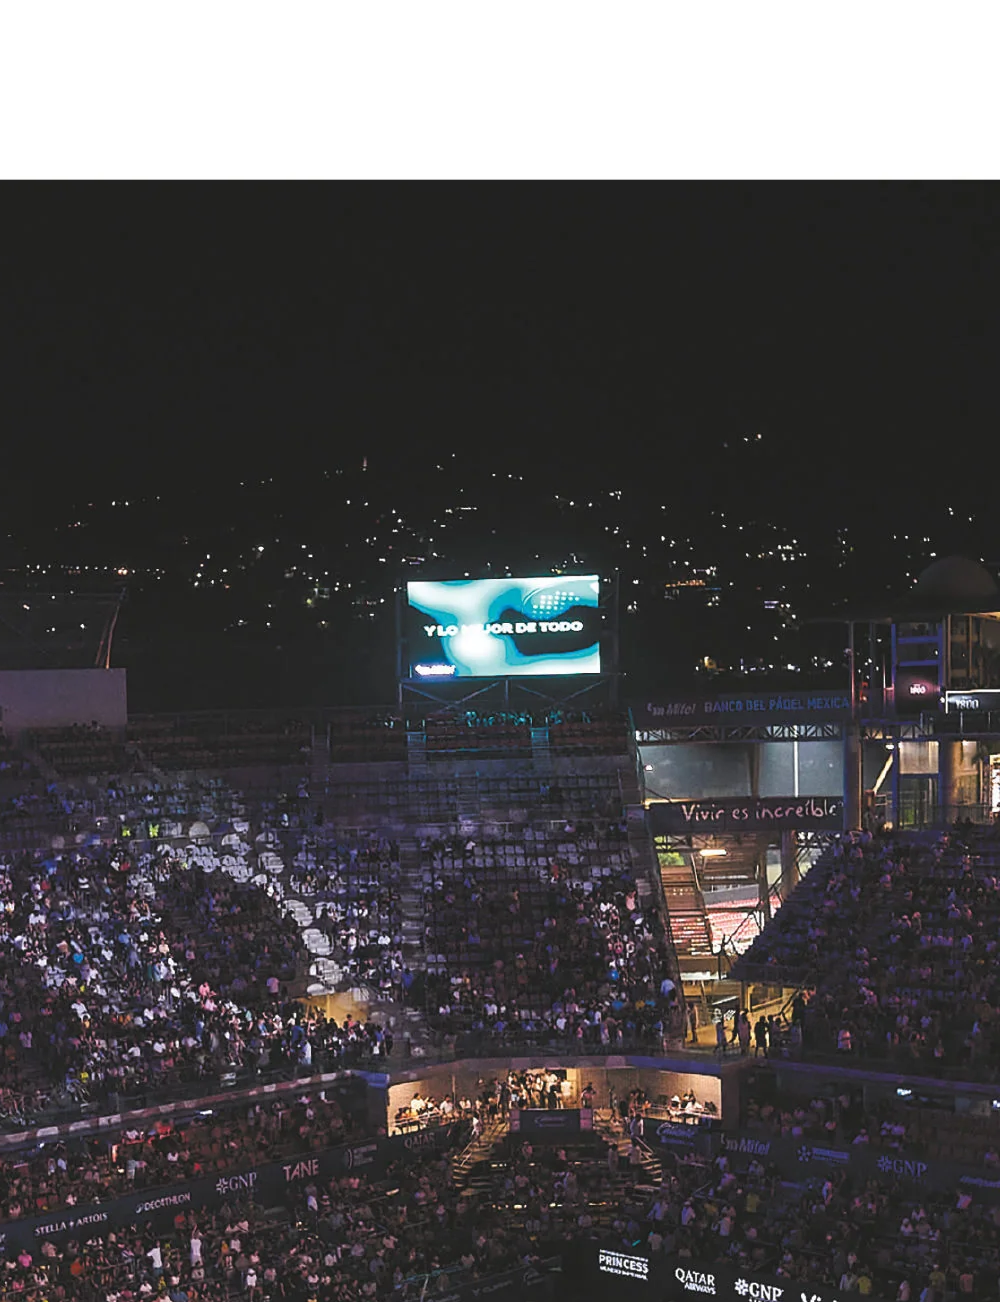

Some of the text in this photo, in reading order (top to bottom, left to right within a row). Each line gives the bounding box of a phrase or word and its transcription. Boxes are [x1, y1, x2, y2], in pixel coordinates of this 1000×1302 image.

[424, 625, 437, 637] Y
[437, 624, 459, 637] LO
[515, 622, 538, 634] DE
[538, 620, 584, 633] TODO
[704, 701, 744, 713] BANCO
[745, 700, 766, 711] DEL
[681, 803, 725, 822] Vivir
[731, 807, 749, 820] es
[282, 1158, 320, 1182] TANE
[892, 1158, 928, 1178] GNP
[229, 1171, 257, 1192] GNP
[34, 1211, 109, 1236] STELLA ARTOIS
[598, 1254, 649, 1274] PRINCESS
[674, 1267, 715, 1287] QATAR
[748, 1282, 784, 1302] GNP
